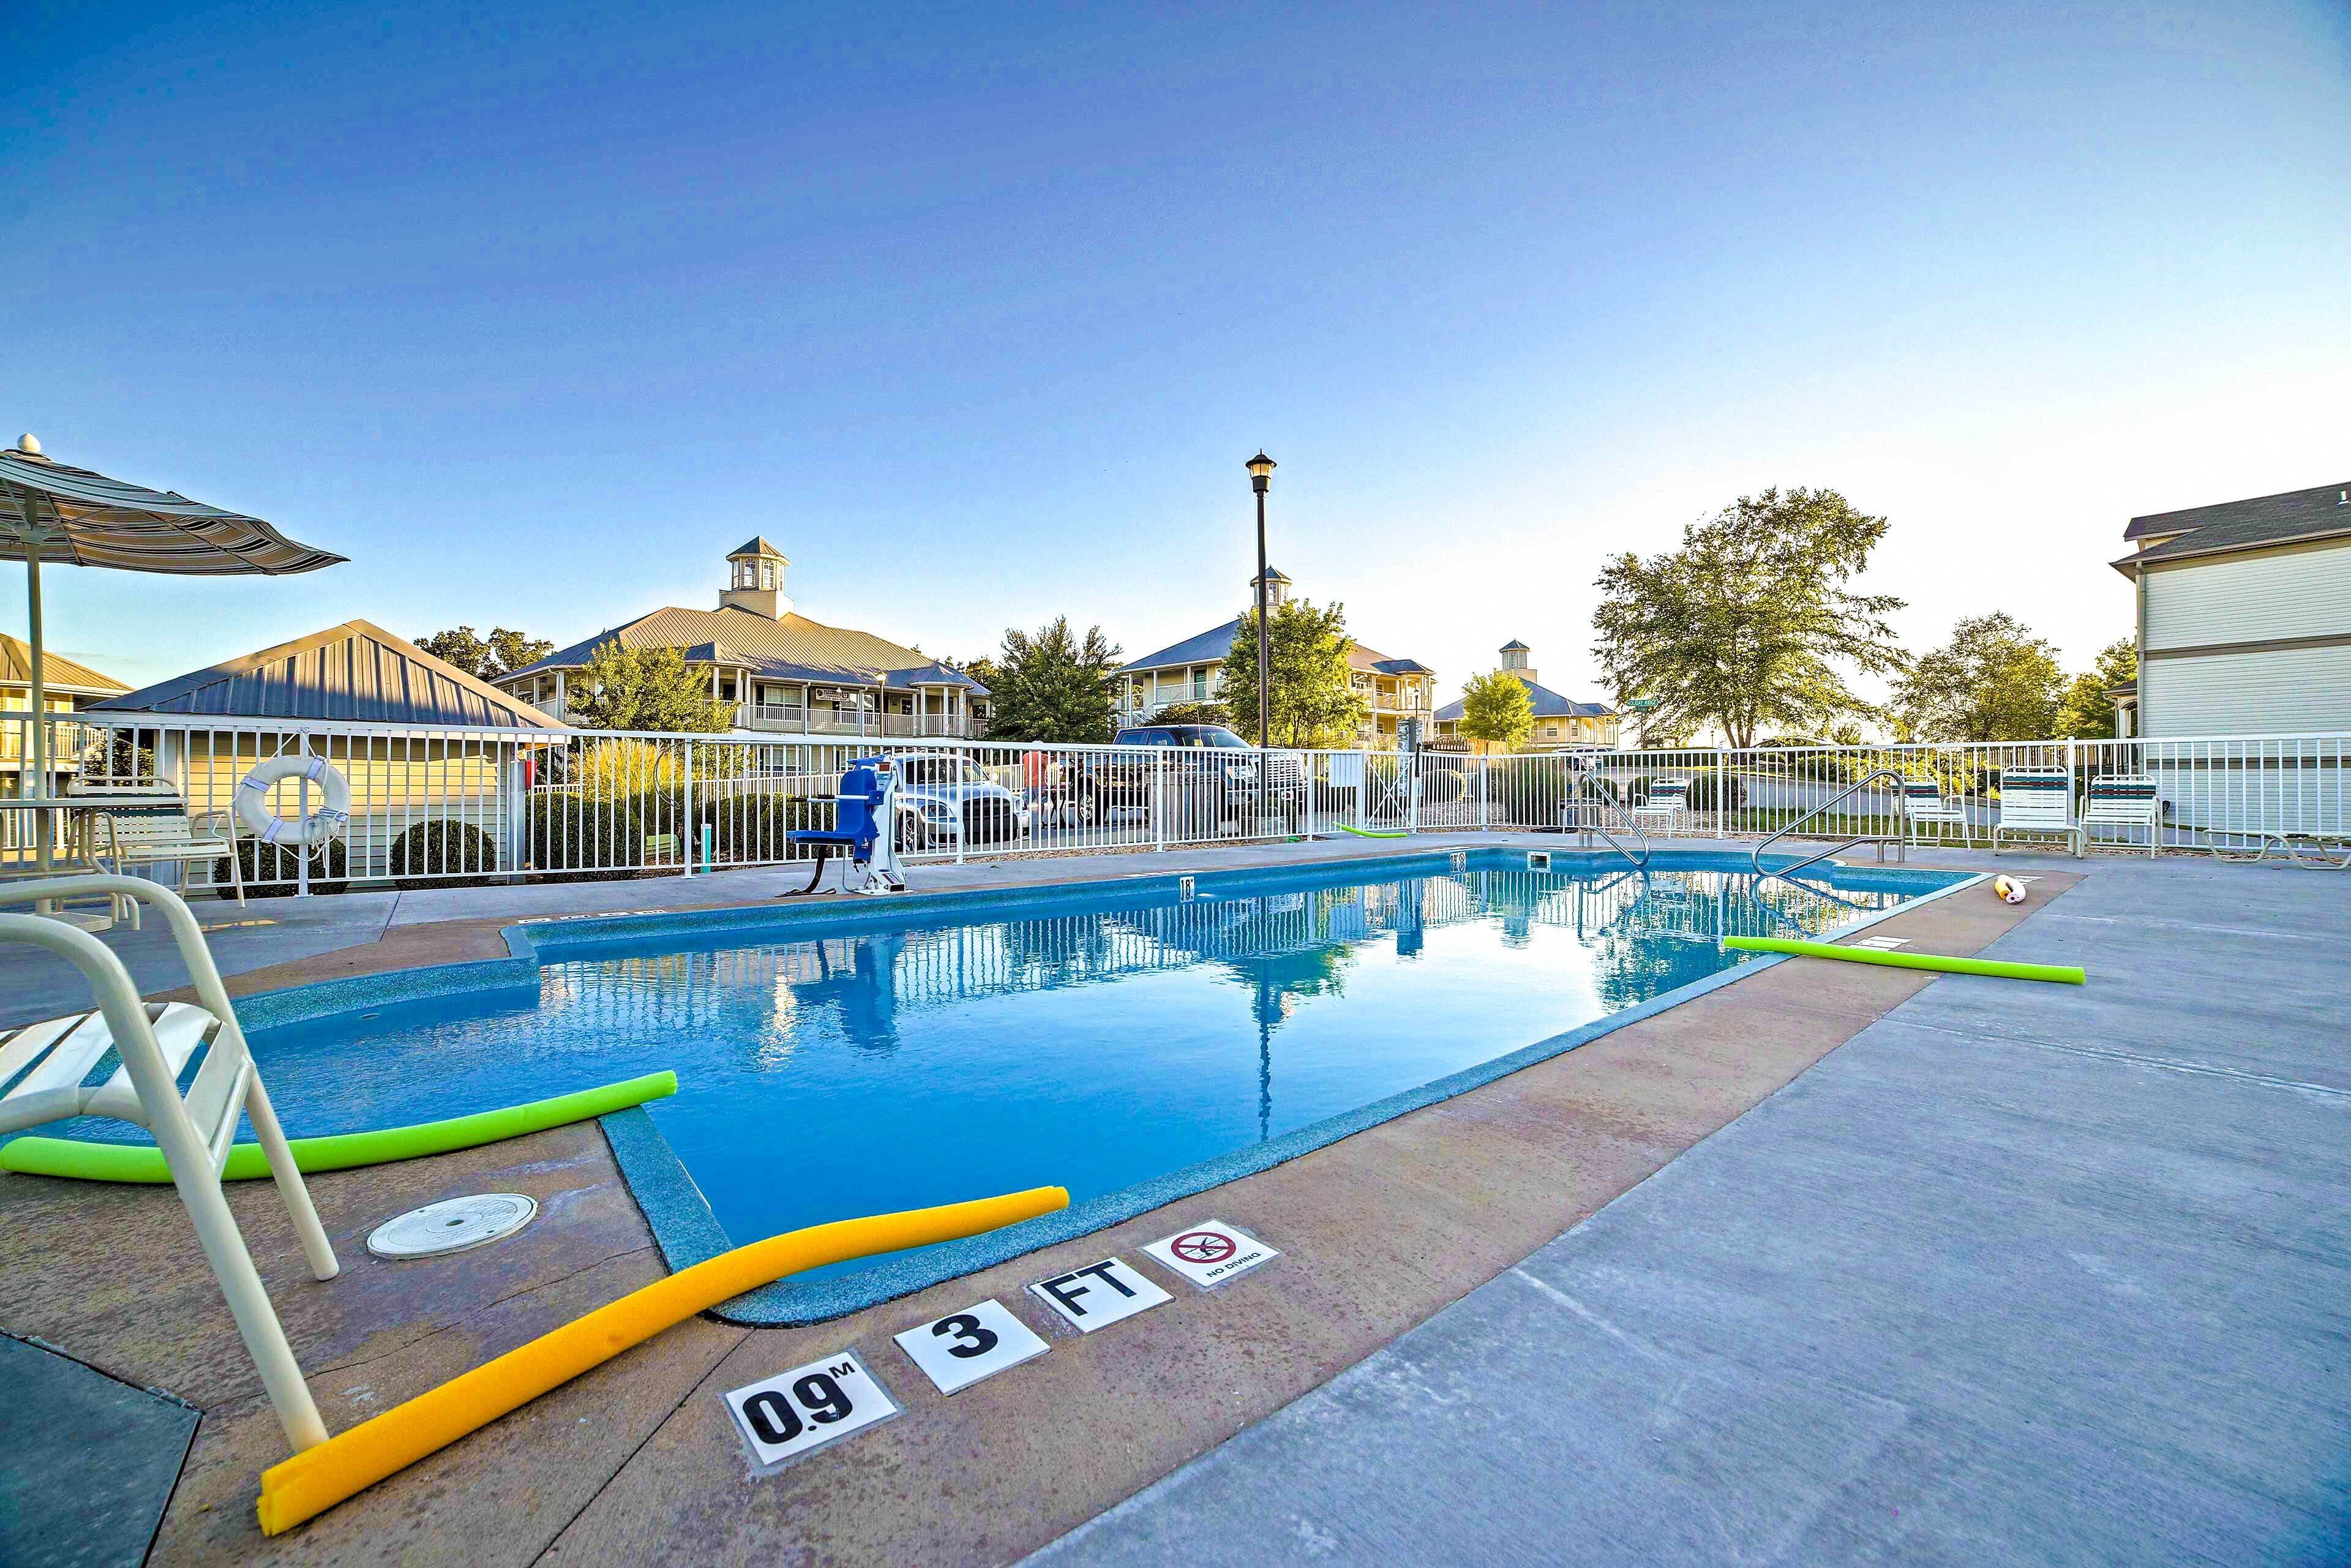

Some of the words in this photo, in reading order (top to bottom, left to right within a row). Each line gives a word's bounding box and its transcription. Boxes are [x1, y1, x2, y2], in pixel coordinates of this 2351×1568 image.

[1206, 1268, 1224, 1277] NO
[1224, 1252, 1261, 1269] DIVING
[932, 1314, 999, 1359] 3
[1040, 1260, 1138, 1316] FT
